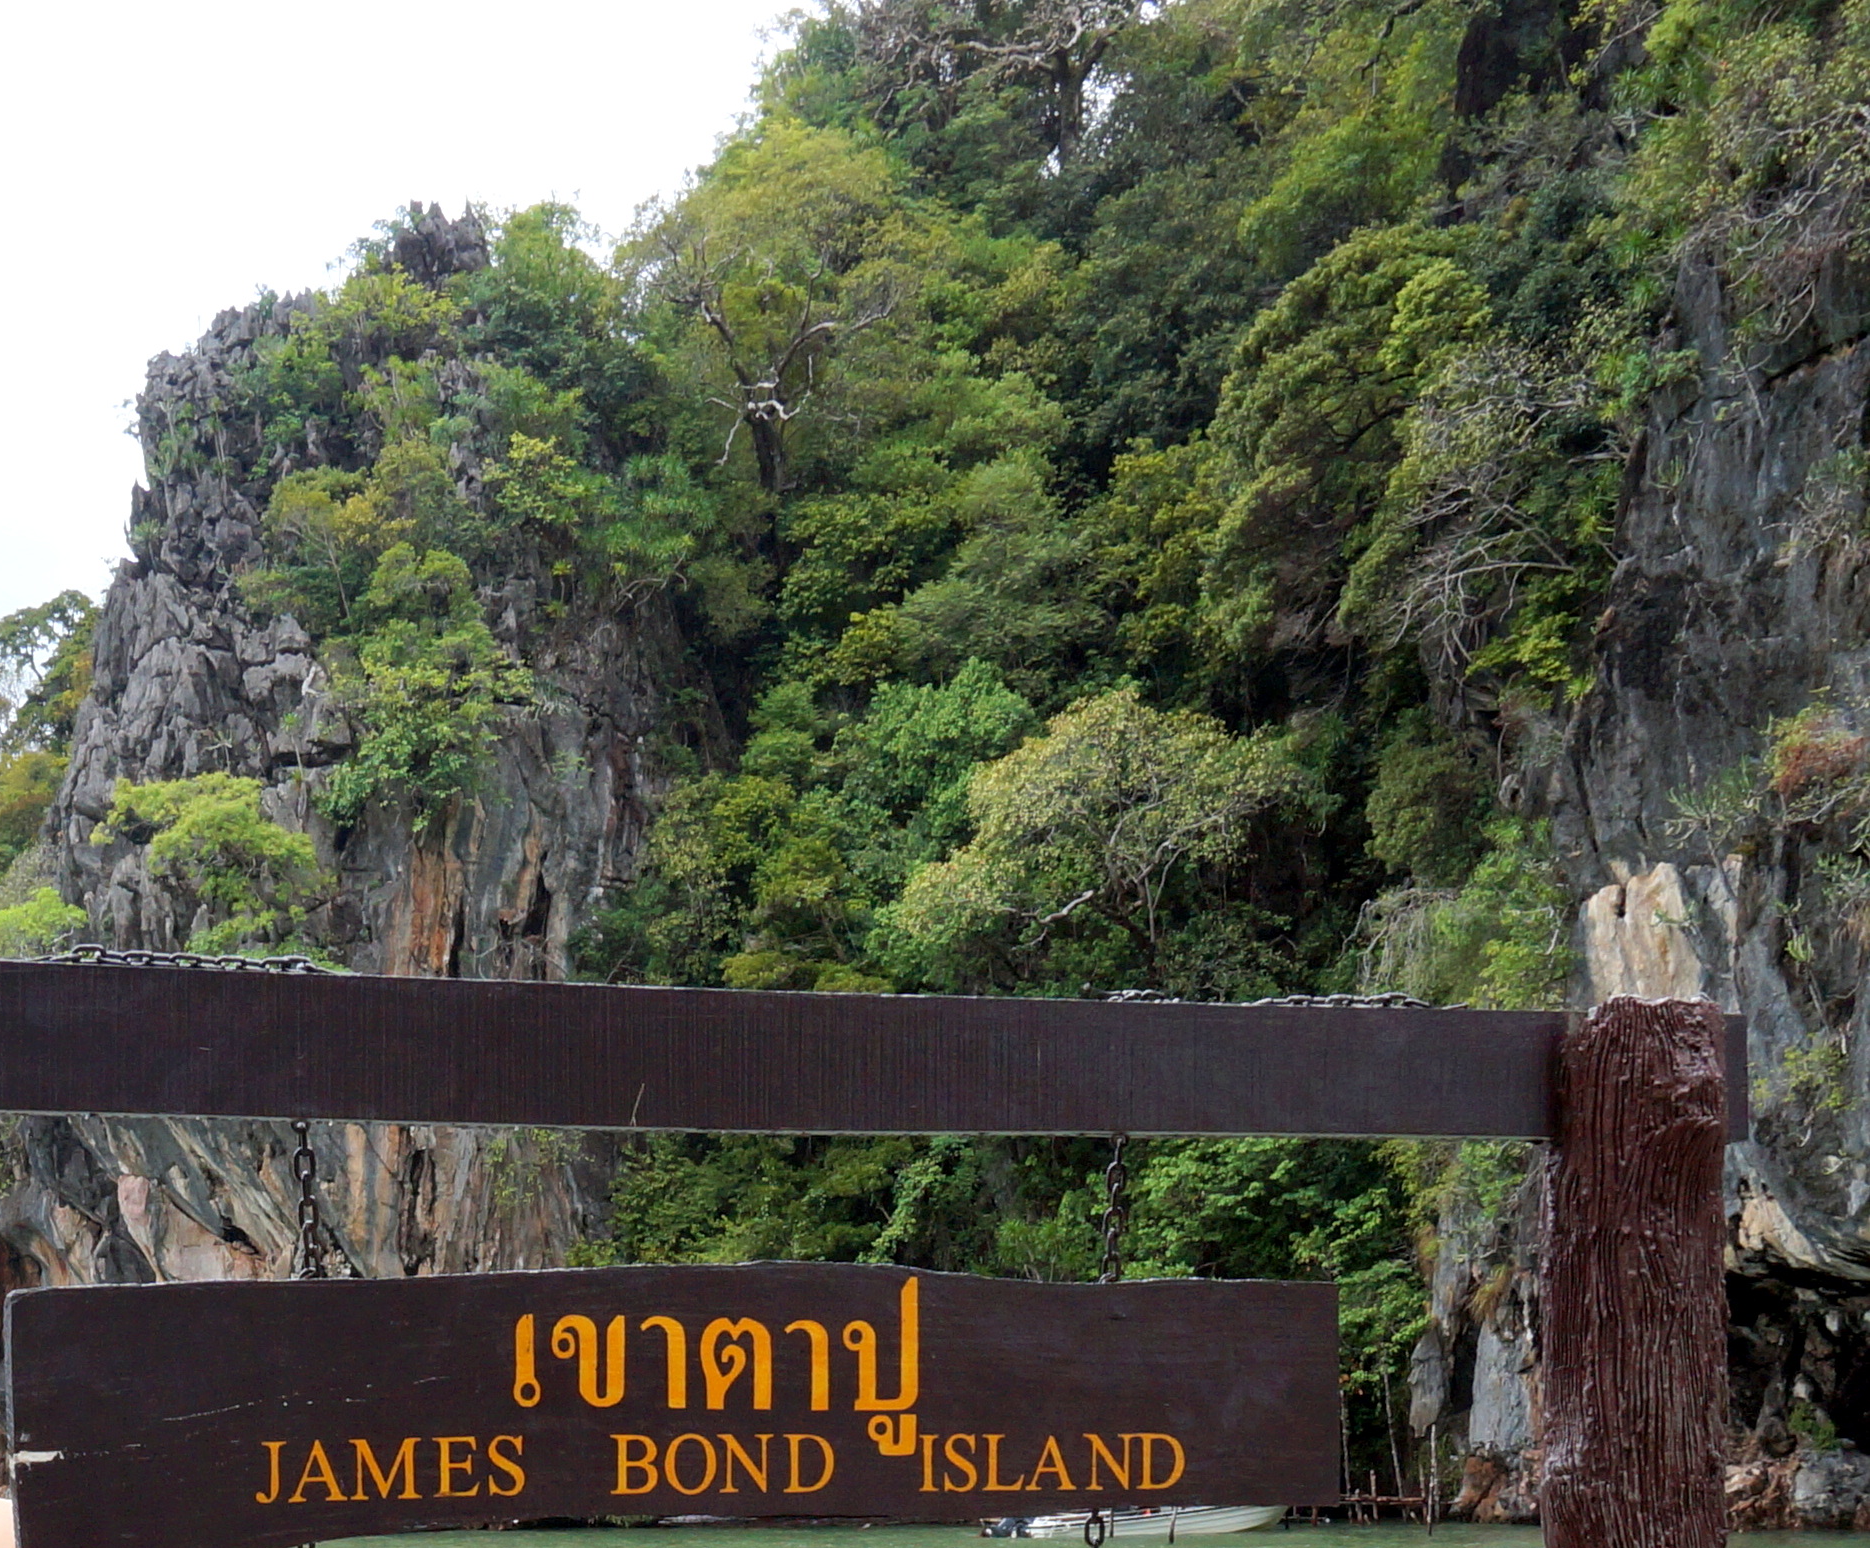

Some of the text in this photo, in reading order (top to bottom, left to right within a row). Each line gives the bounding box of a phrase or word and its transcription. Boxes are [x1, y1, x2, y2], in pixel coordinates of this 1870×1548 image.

[512, 1275, 920, 1457] เขาตาปู
[255, 1432, 1187, 1504] JAMES BOND ISLAND
